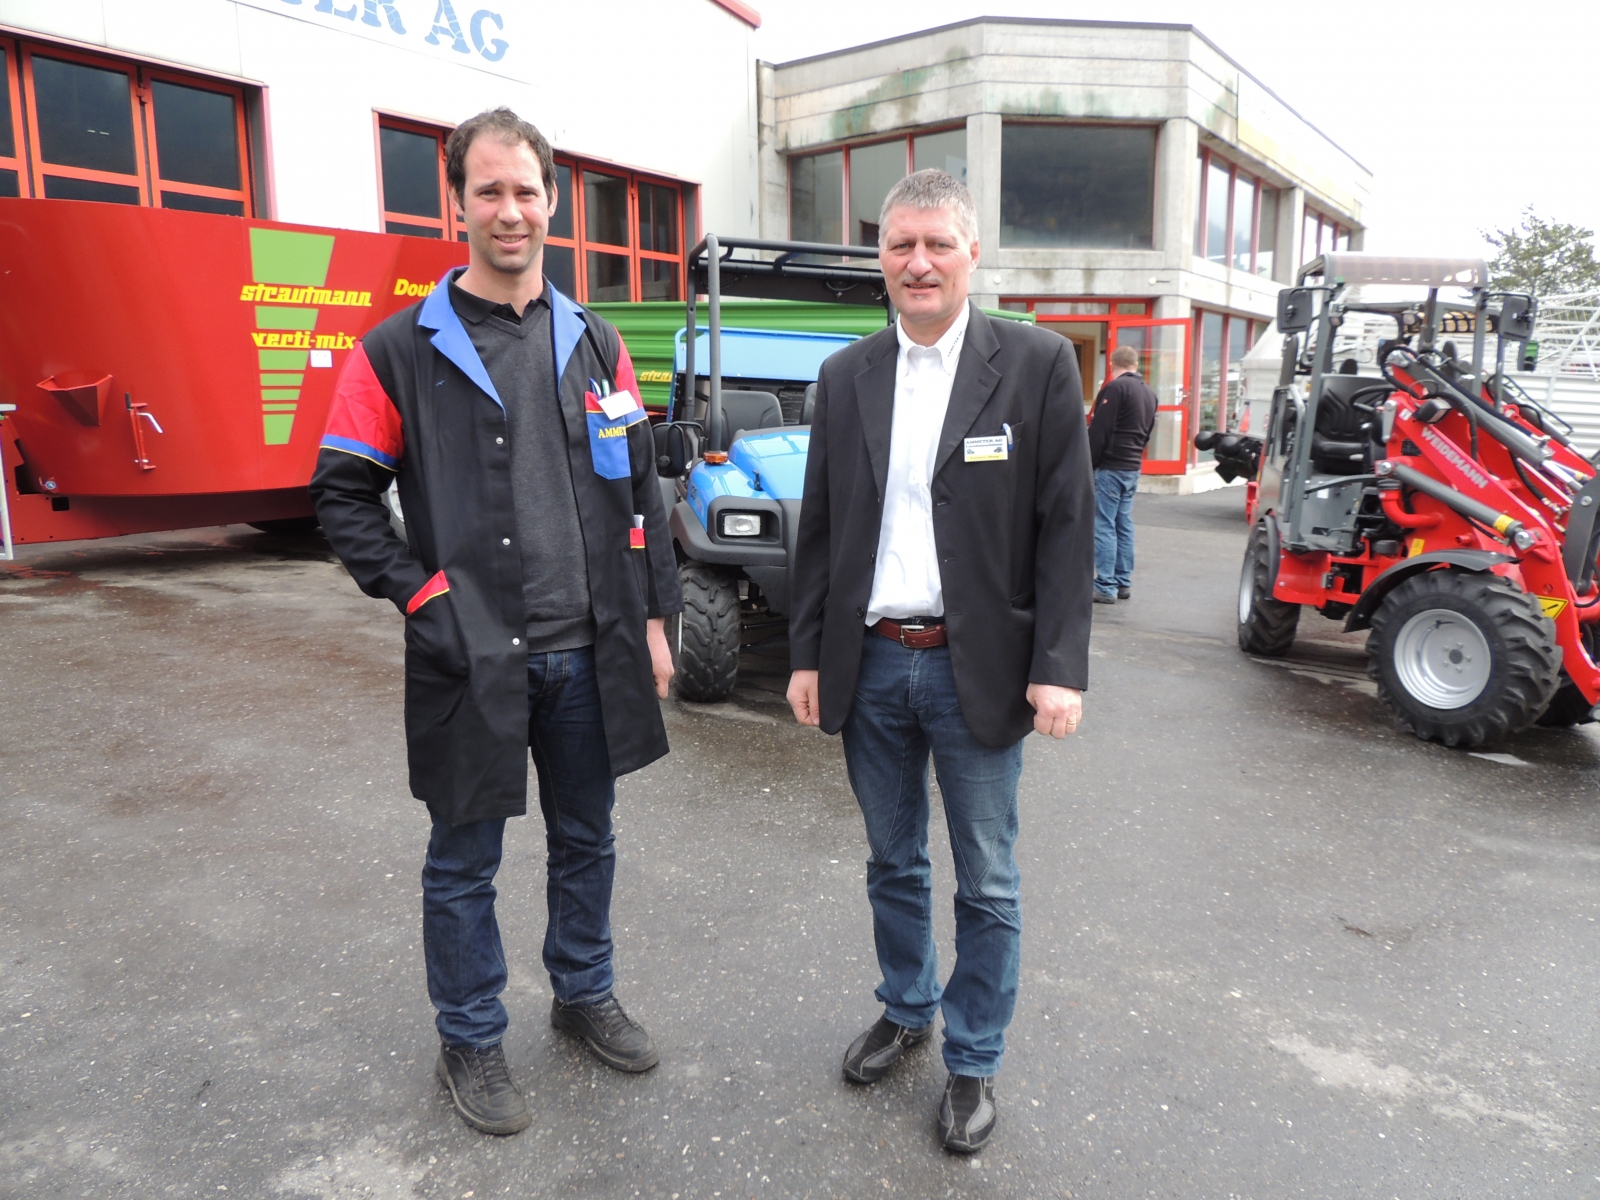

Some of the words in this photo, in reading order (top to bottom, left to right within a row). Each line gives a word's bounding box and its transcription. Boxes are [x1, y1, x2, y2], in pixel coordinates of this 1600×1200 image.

[424, 0, 509, 62] AG
[239, 283, 372, 306] strautmann
[1421, 426, 1489, 489] WEIDEMANN
